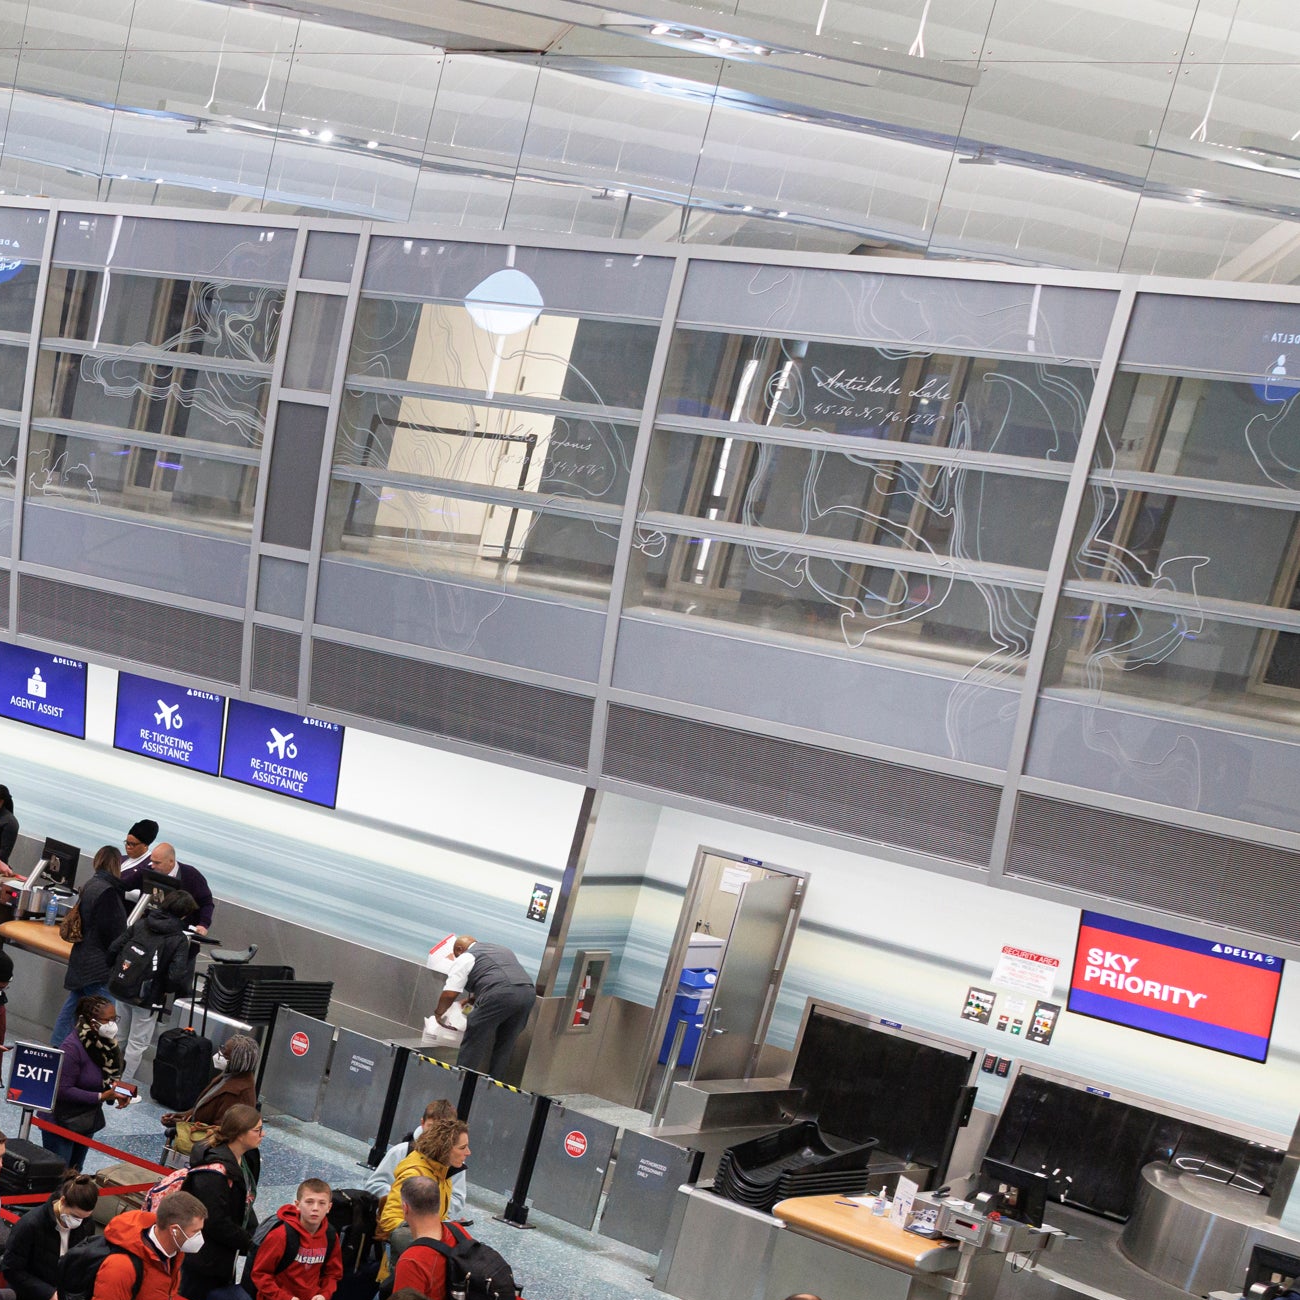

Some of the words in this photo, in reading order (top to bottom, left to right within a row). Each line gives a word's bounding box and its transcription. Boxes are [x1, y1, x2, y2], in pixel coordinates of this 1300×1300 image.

[909, 379, 951, 400] Lake
[58, 657, 77, 667] DELTA
[193, 690, 214, 701] DELTA
[10, 695, 36, 711] AGENT
[37, 702, 64, 718] ASSIST
[309, 718, 332, 730] DELTA
[140, 729, 193, 752] RE-TICKETING
[142, 740, 190, 762] ASSISTANCE
[250, 758, 308, 783] RE-TICKETING
[252, 770, 304, 793] ASSISTANCE
[1002, 946, 1038, 963] SECURITY
[1039, 955, 1060, 967] AREA
[1087, 947, 1139, 974] SKY
[1224, 946, 1263, 962] DELTA
[1084, 965, 1202, 1009] PRIORITY
[29, 1050, 48, 1058] DELTA
[16, 1063, 53, 1083] EXIT
